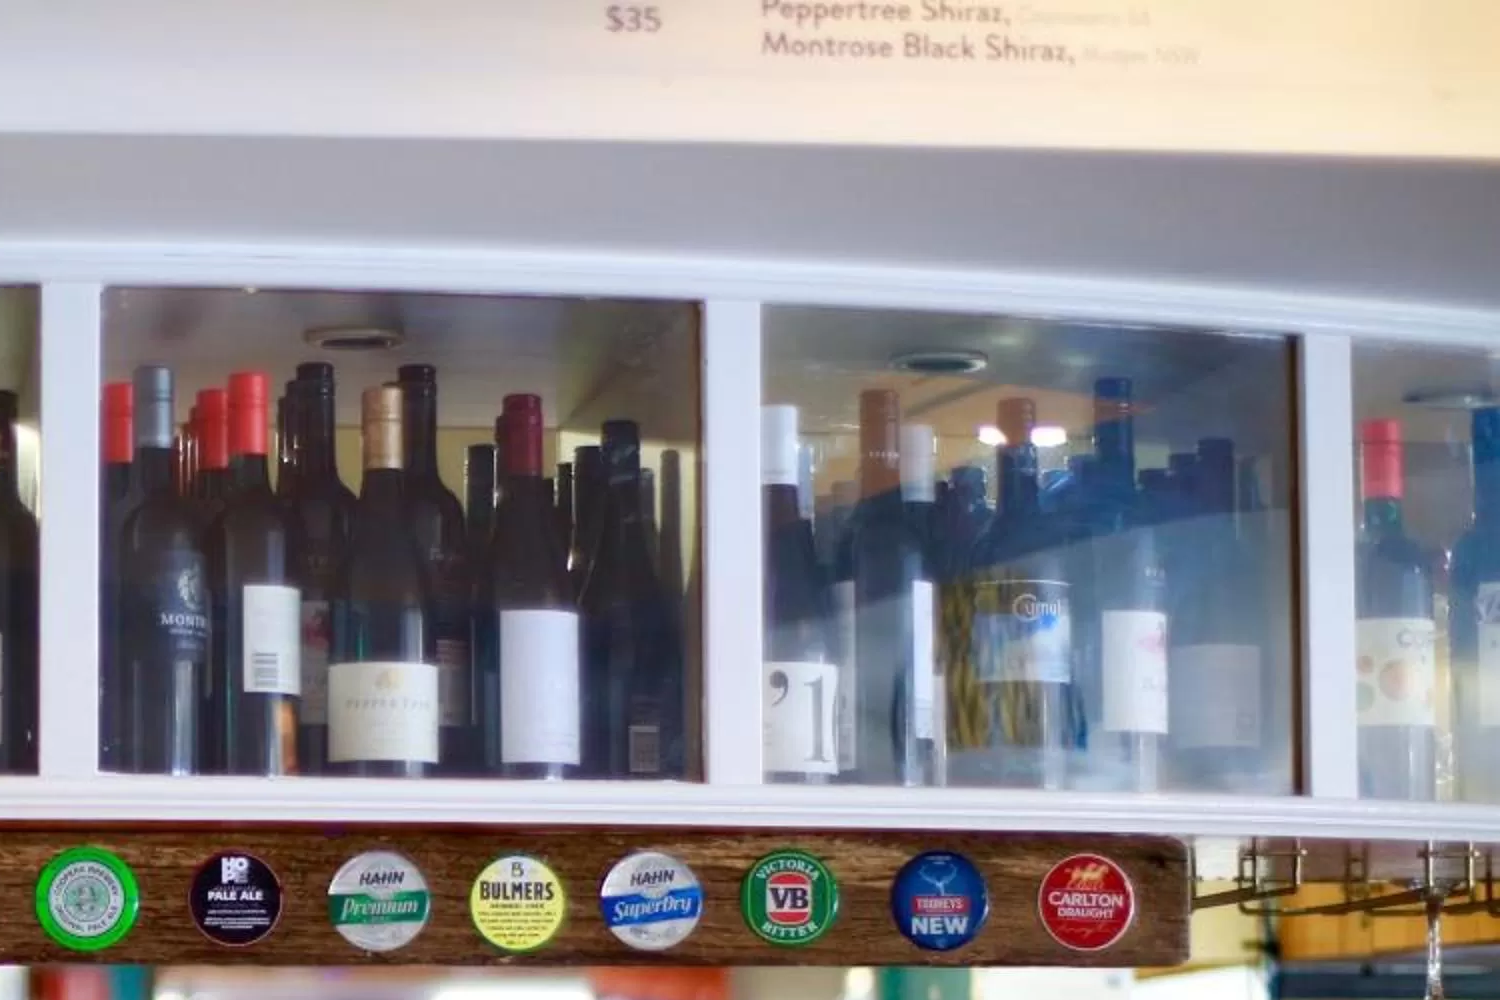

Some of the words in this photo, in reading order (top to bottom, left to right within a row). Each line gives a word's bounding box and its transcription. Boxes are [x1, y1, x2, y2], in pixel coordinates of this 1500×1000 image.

[605, 4, 662, 33] $35
[761, 0, 912, 28] Peppertree
[920, 0, 1012, 27] Shiraz,
[762, 32, 893, 58] Montrose
[902, 32, 977, 60] Black
[984, 32, 1077, 65] Shiraz,
[359, 871, 405, 887] HAHN
[630, 869, 675, 887] HAHN
[755, 859, 820, 881] VICTORIA
[207, 890, 237, 902] PALE
[239, 890, 265, 902] ALE
[479, 881, 555, 901] BULMERS
[769, 887, 810, 910] VB
[1047, 891, 1124, 909] CARLTON
[341, 897, 420, 922] Premium
[612, 895, 693, 921] SuperDry
[915, 897, 965, 909] TOOHEYS
[1057, 906, 1115, 919] DRAUGHT
[761, 921, 819, 938] BITTER
[910, 916, 970, 936] NEW
